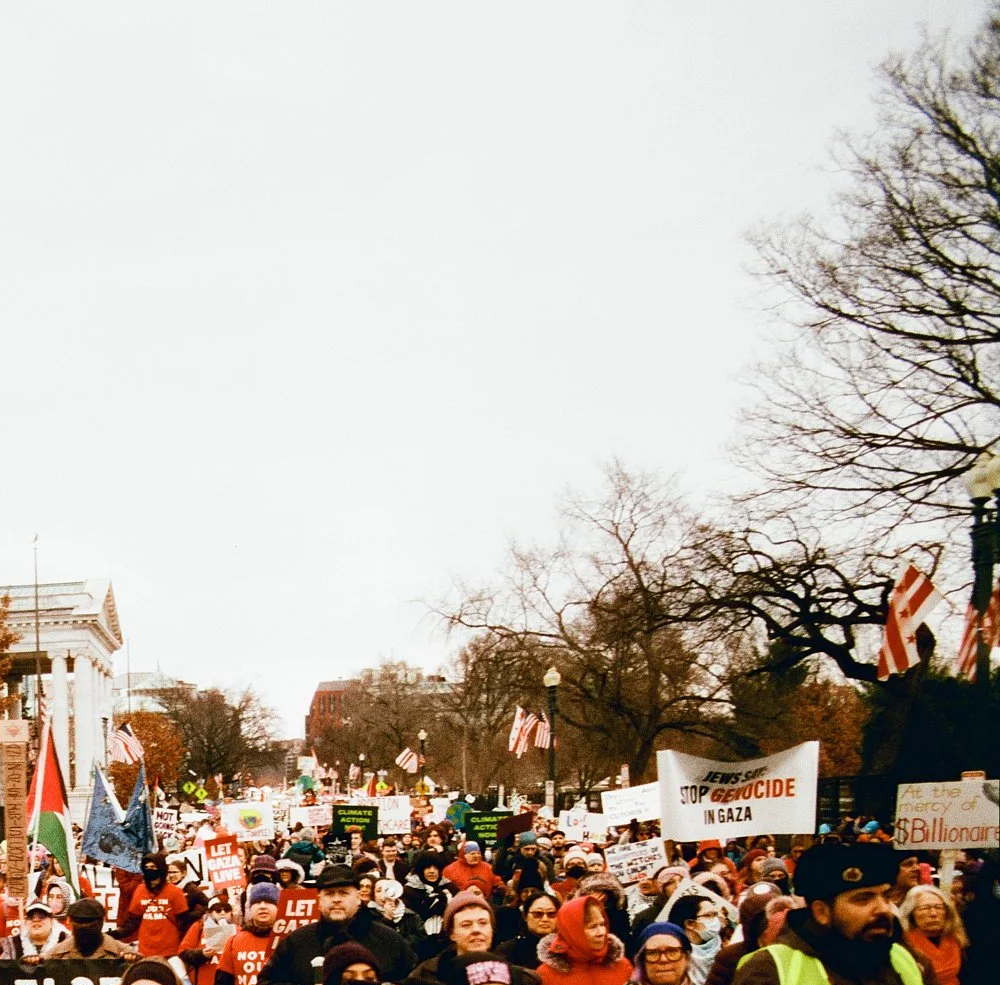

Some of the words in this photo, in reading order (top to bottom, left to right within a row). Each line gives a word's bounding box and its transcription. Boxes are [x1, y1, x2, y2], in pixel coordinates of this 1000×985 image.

[702, 769, 742, 785] JEWS
[680, 785, 709, 805] STOP
[710, 778, 796, 804] GENOCIDE
[901, 785, 922, 799] At
[932, 785, 961, 799] the
[900, 801, 952, 816] mercy
[961, 796, 980, 811] of
[704, 809, 715, 825] IN
[718, 806, 753, 824] GAZA
[210, 842, 232, 857] LET
[208, 855, 241, 871] GAZA
[212, 868, 241, 884] LIVE
[285, 899, 316, 917] LET
[272, 919, 319, 934] GA
